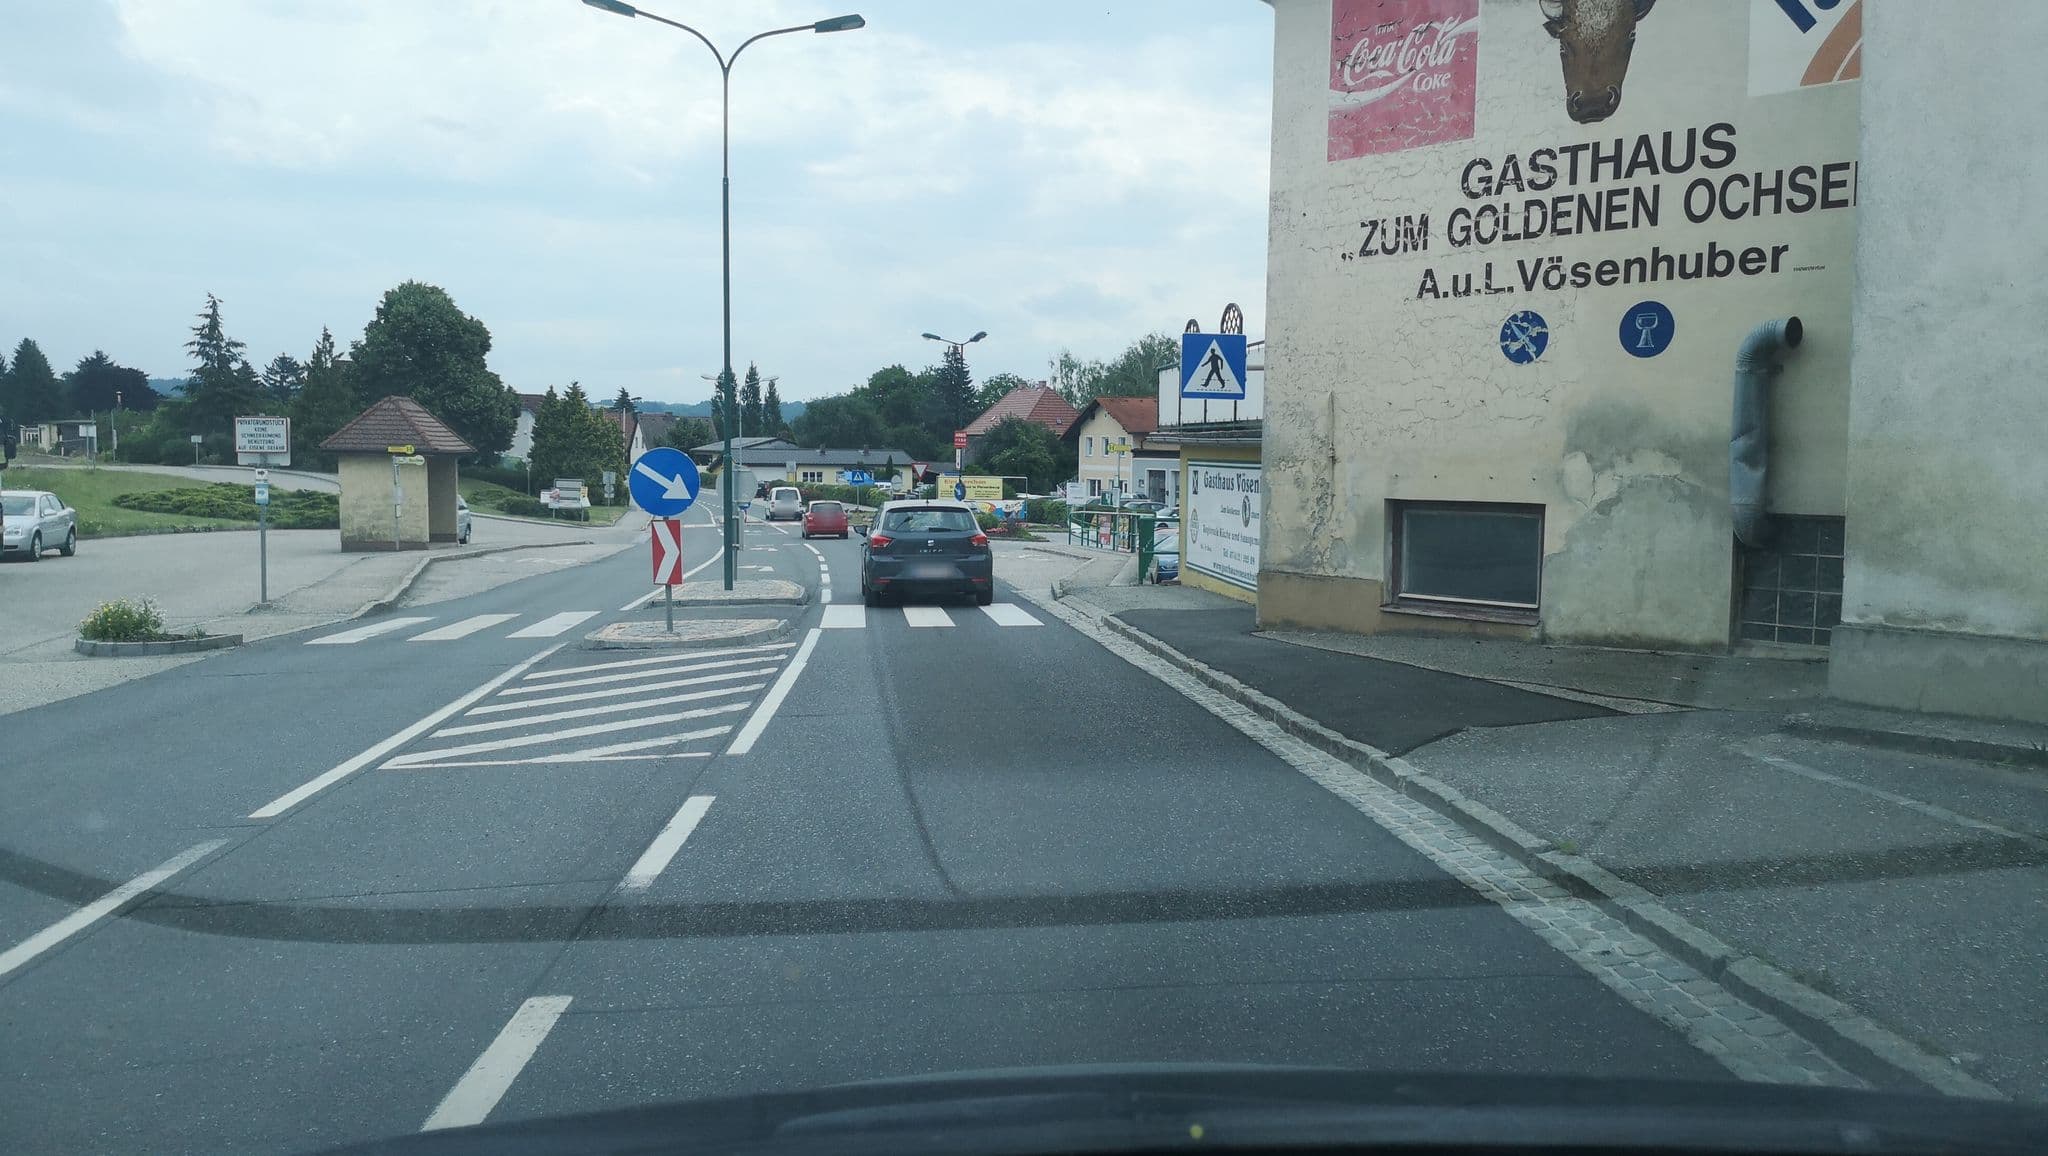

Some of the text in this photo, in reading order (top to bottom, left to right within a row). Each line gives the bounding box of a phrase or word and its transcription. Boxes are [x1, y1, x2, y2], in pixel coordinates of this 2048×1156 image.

[1337, 16, 1457, 87] Coca-Cola
[1412, 72, 1452, 93] Coke
[1461, 122, 1737, 200] GASTHAUS
[1447, 183, 1661, 248] GOLDENEN
[1683, 160, 1859, 224] OCHSE
[1203, 471, 1261, 494] Gasthaus Vösen
